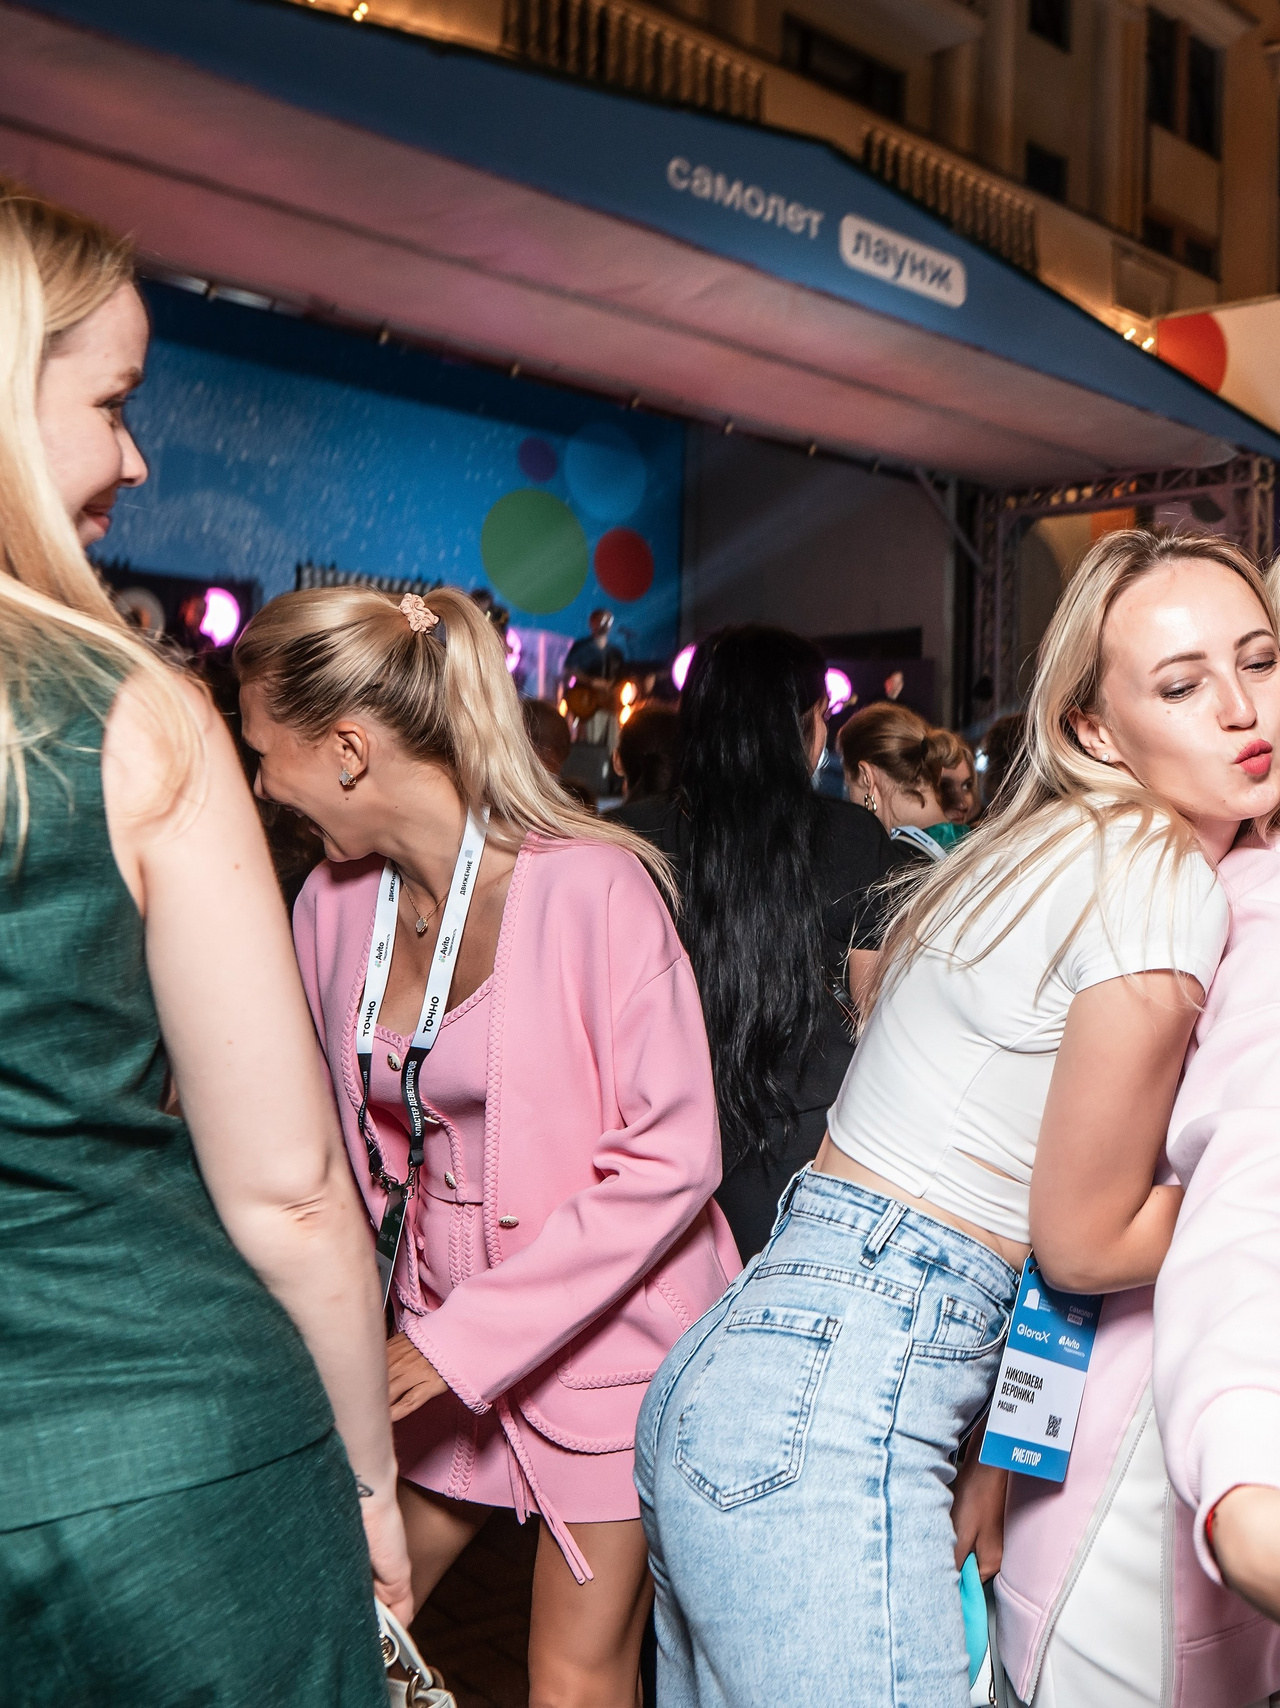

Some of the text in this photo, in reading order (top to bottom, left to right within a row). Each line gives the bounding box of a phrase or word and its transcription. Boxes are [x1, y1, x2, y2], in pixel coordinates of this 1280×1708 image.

[666, 156, 953, 294] самолет лаунж
[460, 860, 473, 895] ДВИЖЕНИЕ
[375, 941, 385, 960] Avito
[440, 936, 450, 955] Avito
[363, 1000, 376, 1037] ТОЧНО
[422, 996, 440, 1034] ТОЧНО
[405, 1060, 422, 1137] КЛАСТЕР ДЕВЕЛОПЕРОВ
[1064, 1336, 1080, 1350] Avito
[1004, 1366, 1044, 1391] НИКОЛАЕВА
[1001, 1381, 1035, 1404] ВЕРОНИКА
[997, 1399, 1018, 1414] РАСЦВЕТ
[1011, 1446, 1042, 1467] РИЕЛТОР
